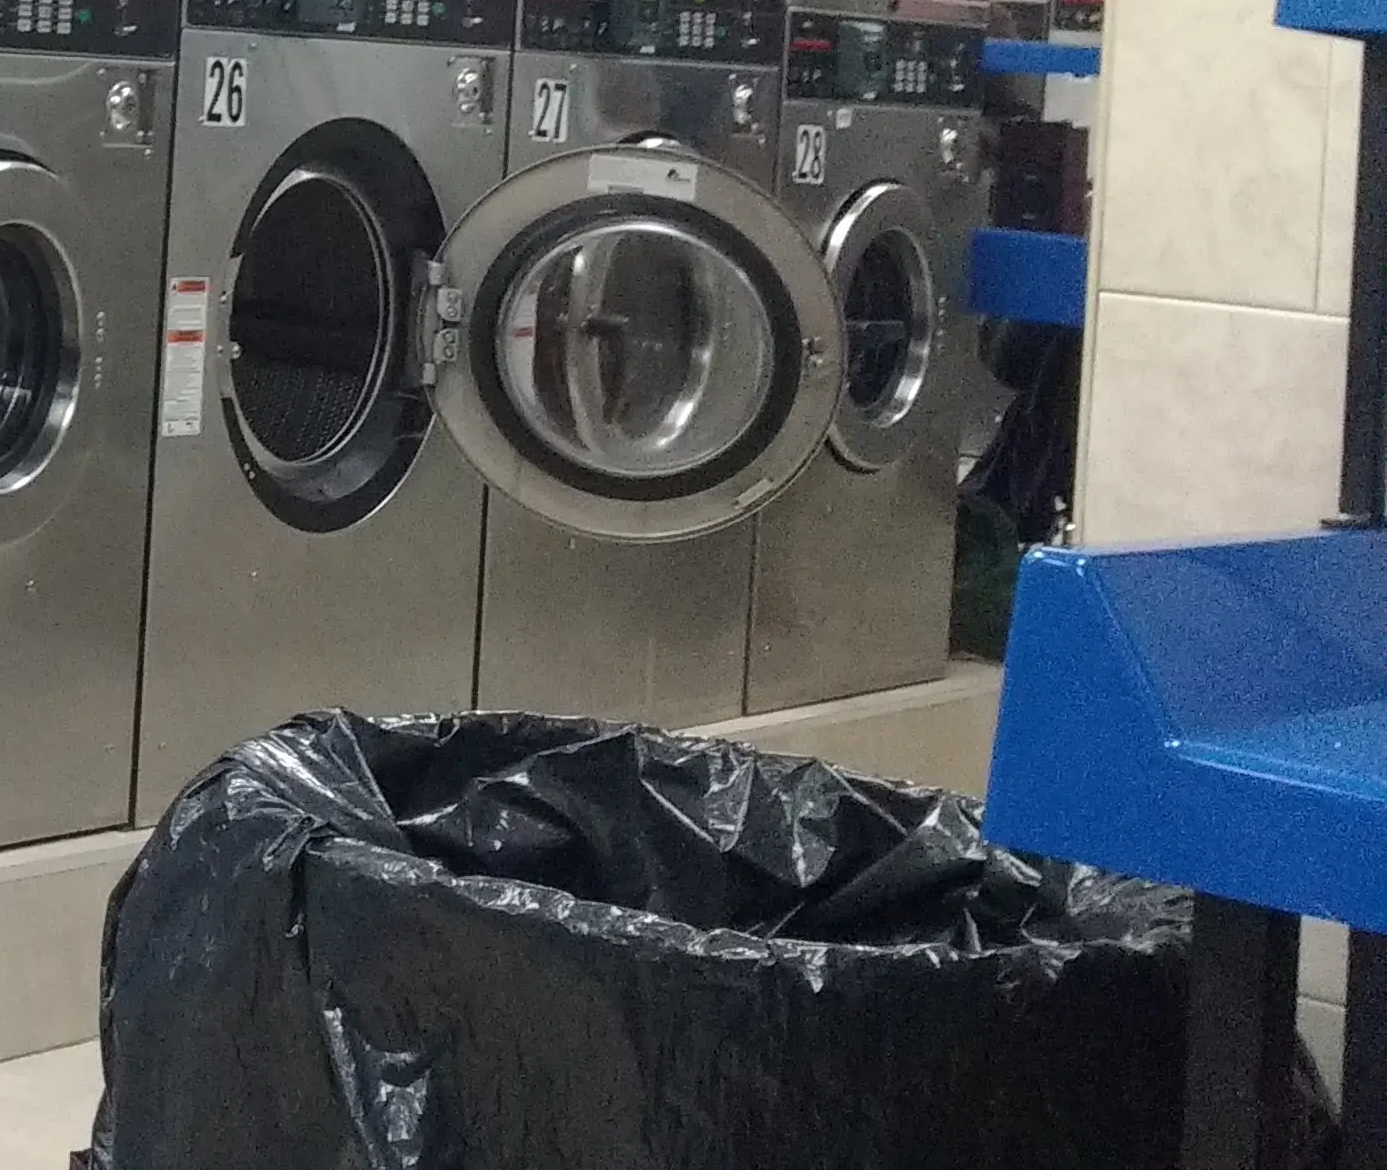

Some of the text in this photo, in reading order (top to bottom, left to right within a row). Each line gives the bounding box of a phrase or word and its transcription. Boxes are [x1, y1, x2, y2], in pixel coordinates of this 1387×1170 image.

[207, 60, 243, 123] 26
[536, 83, 567, 139] 27
[798, 130, 822, 179] 28
